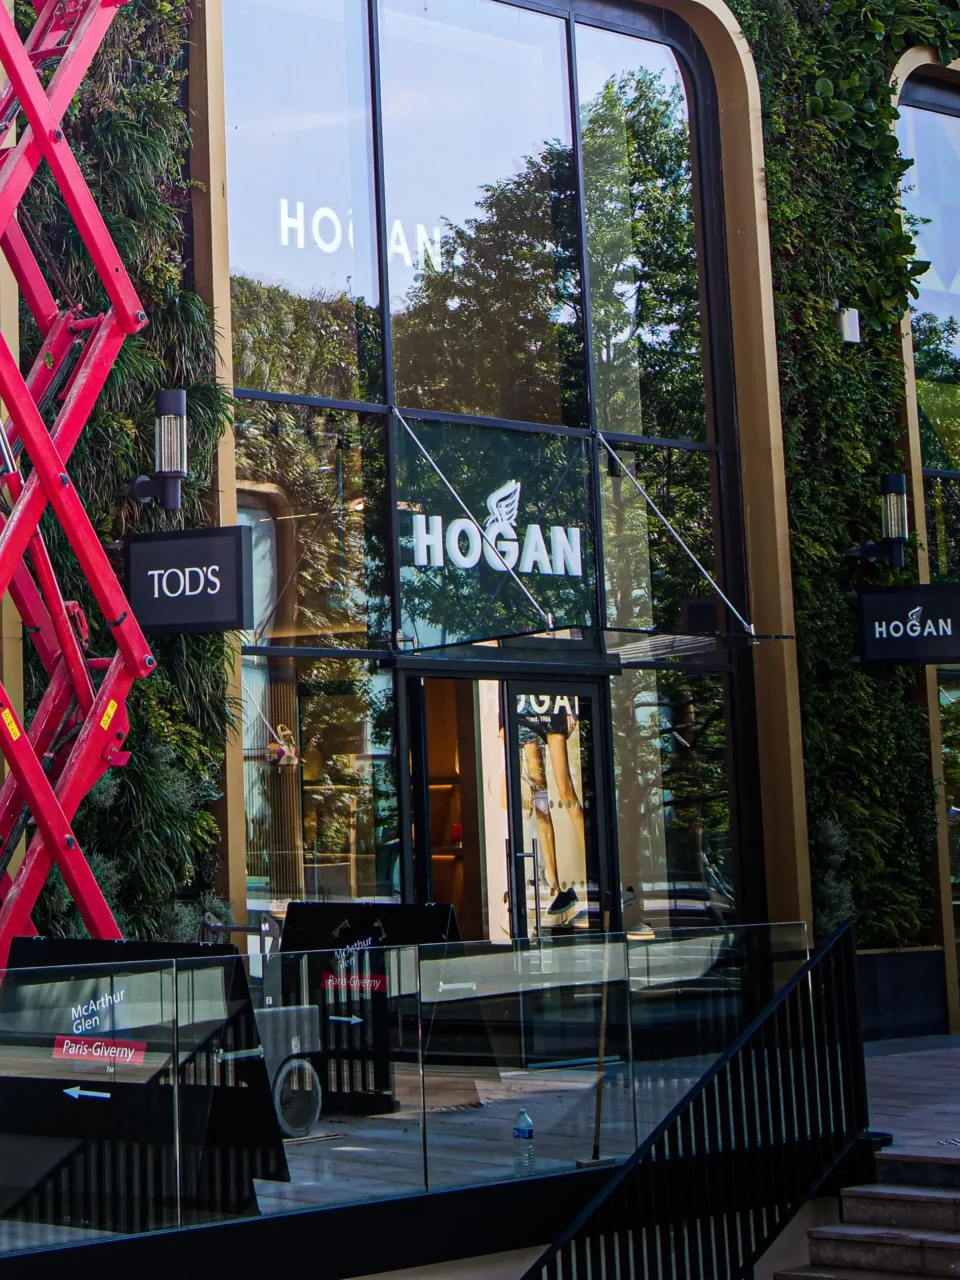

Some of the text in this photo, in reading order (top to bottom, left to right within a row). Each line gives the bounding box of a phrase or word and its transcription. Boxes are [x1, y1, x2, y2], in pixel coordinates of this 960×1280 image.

[280, 198, 442, 272] HOAN
[412, 514, 583, 577] HOGAN
[147, 564, 221, 599] TOD'S
[874, 618, 952, 638] HOGAN
[328, 974, 381, 990] Paris-Giverny
[71, 990, 125, 1020] McArthur
[73, 1016, 100, 1034] Glen
[62, 1039, 135, 1062] Paris-Giverny
